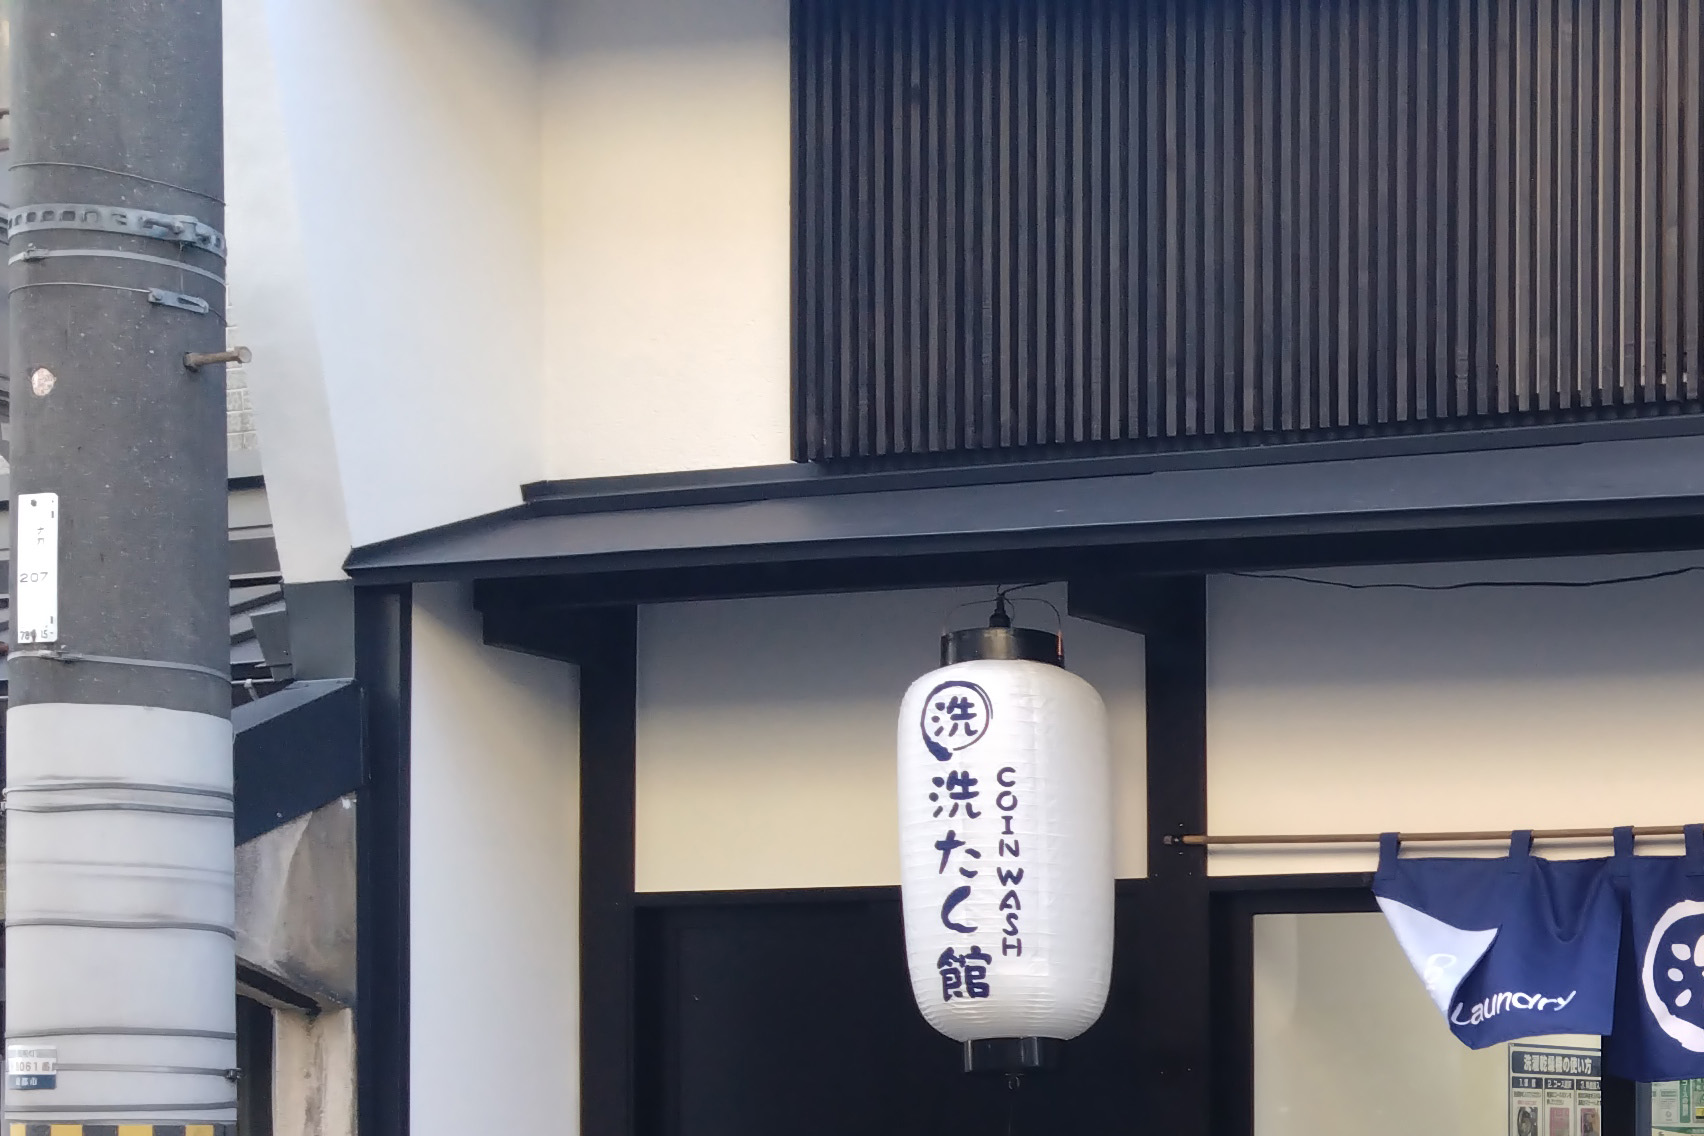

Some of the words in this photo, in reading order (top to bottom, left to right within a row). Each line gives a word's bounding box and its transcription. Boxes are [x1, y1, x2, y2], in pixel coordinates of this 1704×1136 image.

[19, 572, 49, 583] 207
[932, 696, 978, 737] 洗
[995, 766, 1020, 859] COIN
[929, 769, 993, 1002] 洗たく館
[996, 867, 1024, 958] WASH
